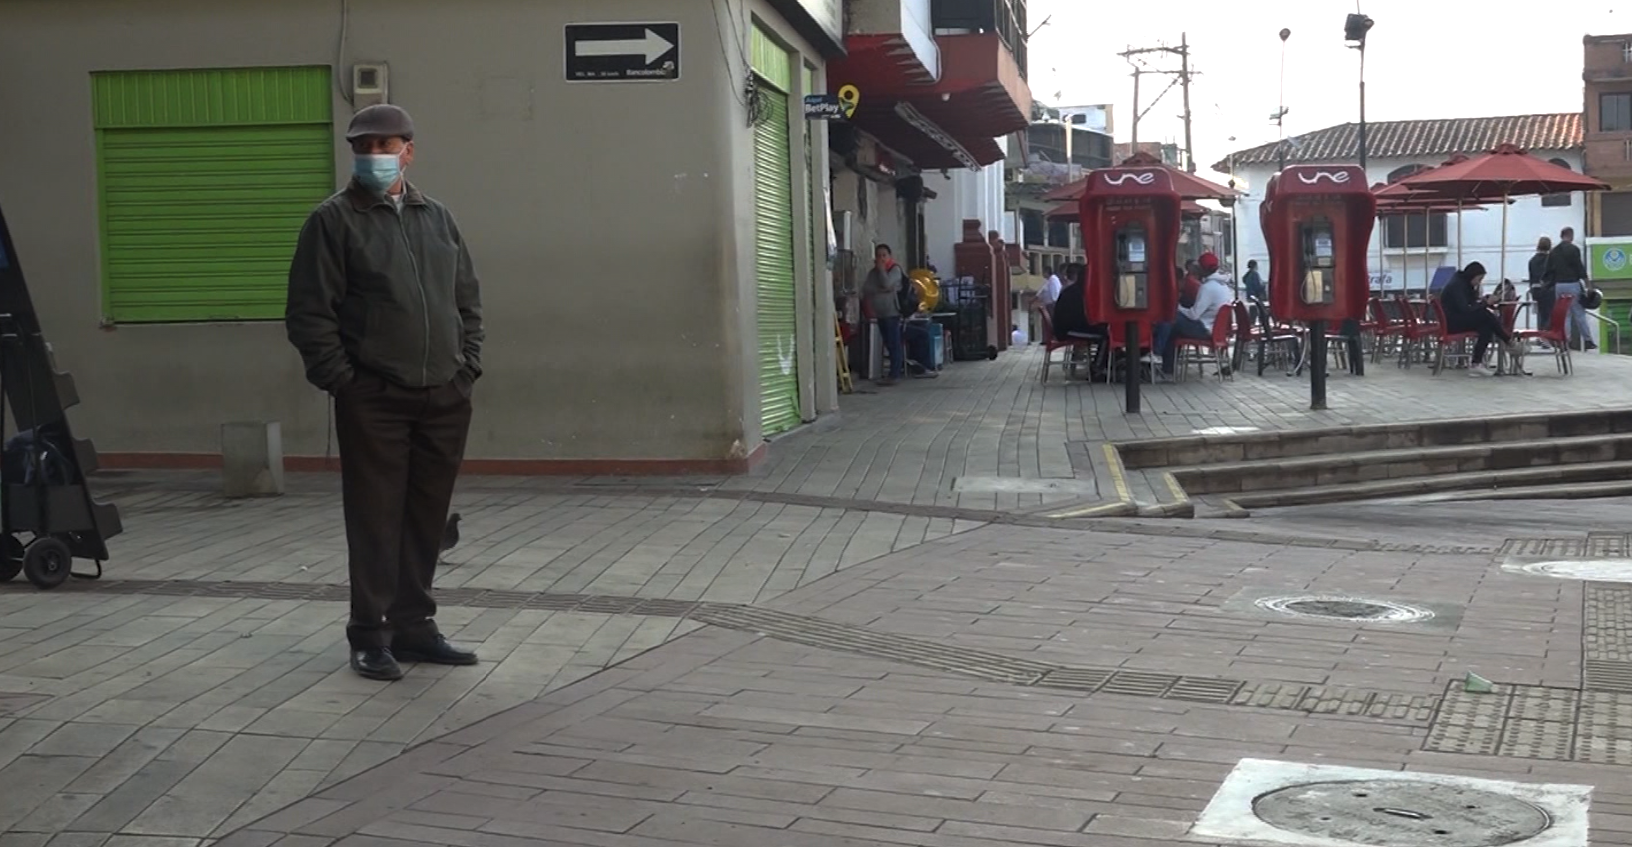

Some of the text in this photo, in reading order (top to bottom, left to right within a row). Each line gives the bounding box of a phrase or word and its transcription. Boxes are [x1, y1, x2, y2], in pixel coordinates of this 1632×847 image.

[805, 103, 840, 114] BetPlay
[1104, 172, 1155, 186] une
[1297, 171, 1351, 184] une
